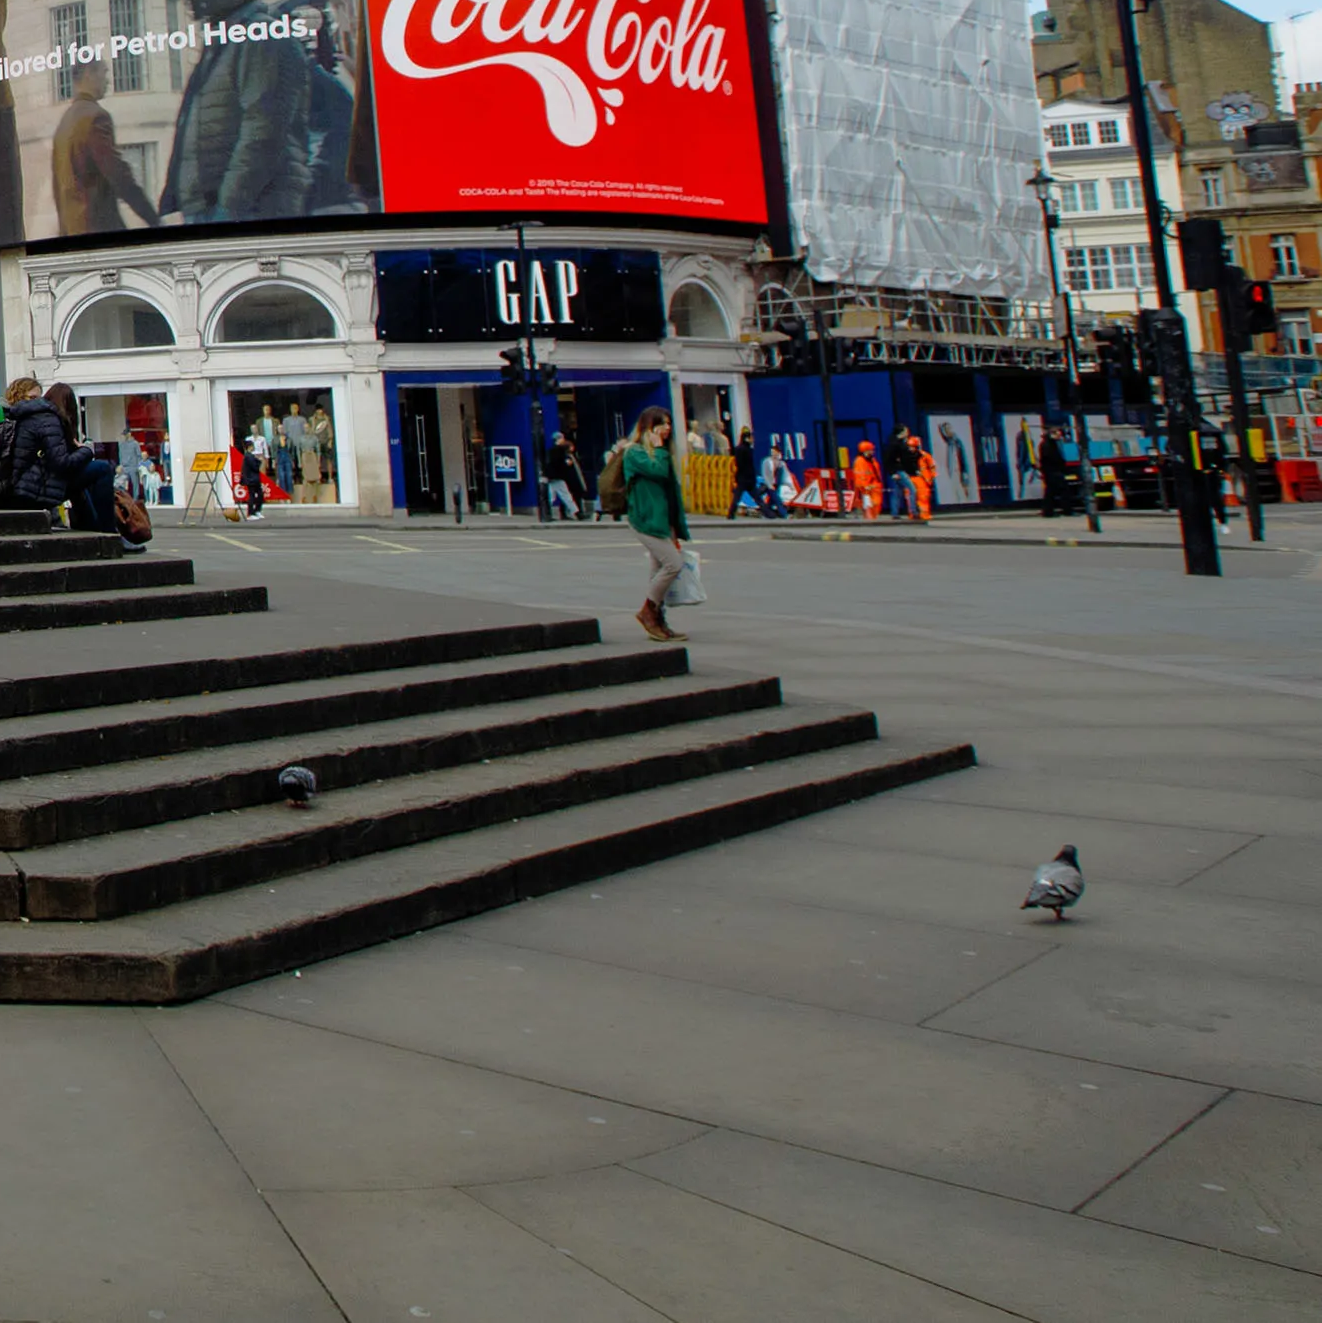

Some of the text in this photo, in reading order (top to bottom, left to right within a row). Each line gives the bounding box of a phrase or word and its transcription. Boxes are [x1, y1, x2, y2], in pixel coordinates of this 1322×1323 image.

[67, 41, 105, 67] for
[111, 24, 196, 60] Petrol
[204, 14, 318, 48] Heads.
[459, 188, 507, 196] COCA-COLA
[495, 259, 579, 325] GAP
